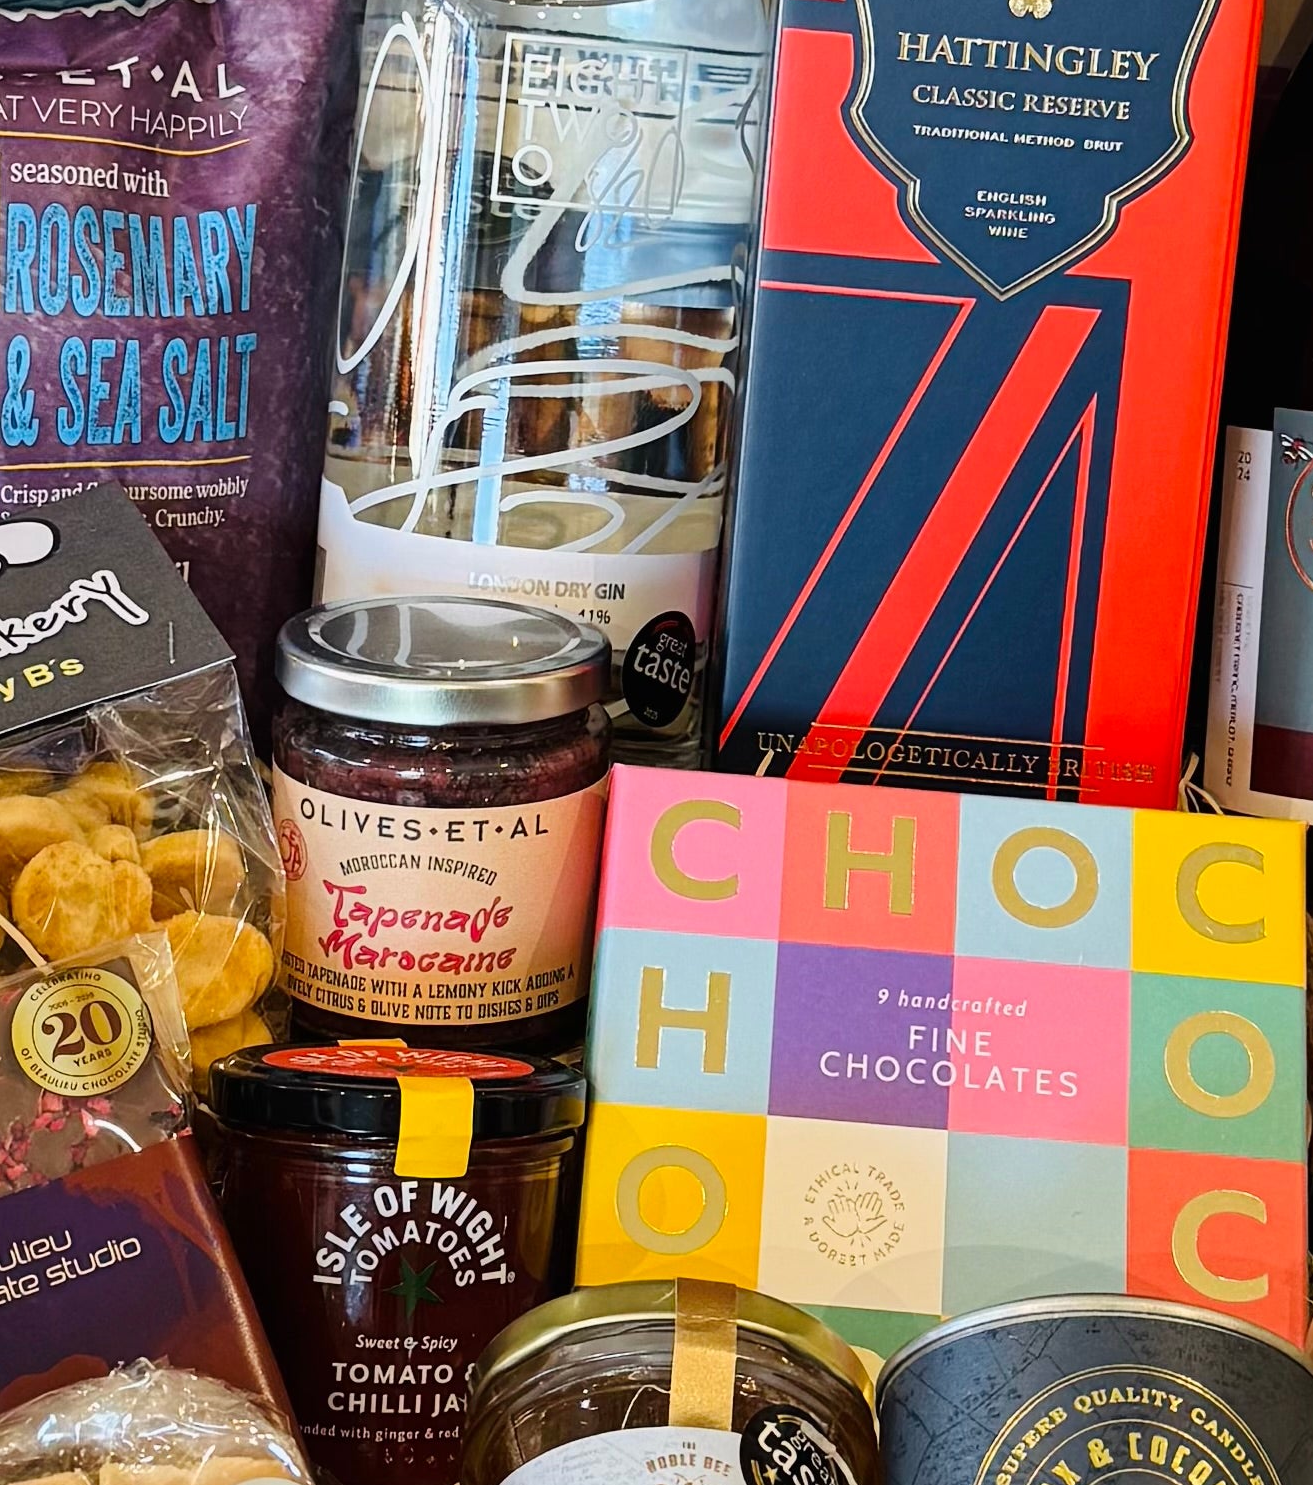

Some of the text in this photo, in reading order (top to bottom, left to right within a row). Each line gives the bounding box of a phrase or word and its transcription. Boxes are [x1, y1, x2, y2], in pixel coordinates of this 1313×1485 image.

[896, 32, 1160, 81] HATTINGLEY
[911, 84, 1131, 120] CLASSIC RESERVE
[131, 106, 248, 141] HAPPILY
[913, 125, 1008, 143] TRADITIONAL
[10, 159, 169, 197] seasoned with
[964, 206, 1057, 224] SPARKLING
[976, 191, 1048, 206] ENGLISH
[987, 224, 1028, 239] WINE
[5, 203, 257, 317] ROSEMARY
[1, 332, 257, 446] & SEA SALT
[155, 506, 226, 528] Crunchy.
[595, 581, 625, 600] GIN
[757, 730, 1042, 774] UNAPOLOGETICALLY
[339, 853, 498, 887] MOROCCAN INSPIRED
[323, 880, 514, 942] Tapenade
[319, 931, 517, 974] Marocaine
[428, 980, 487, 999] LEMONY
[898, 988, 1028, 1018] handcrafted
[42, 995, 125, 1061] 20
[907, 1025, 992, 1056] FINE
[819, 1052, 1080, 1096] CHOCOLATES
[313, 1181, 509, 1285] ISLE OF WIGHT
[48, 1236, 142, 1290] studio
[349, 1220, 476, 1288] TOMATOES
[421, 1335, 458, 1353] Spicy
[332, 1362, 453, 1385] TOMATO
[327, 1392, 422, 1414] CHILLI
[1073, 1387, 1183, 1414] QUALITY
